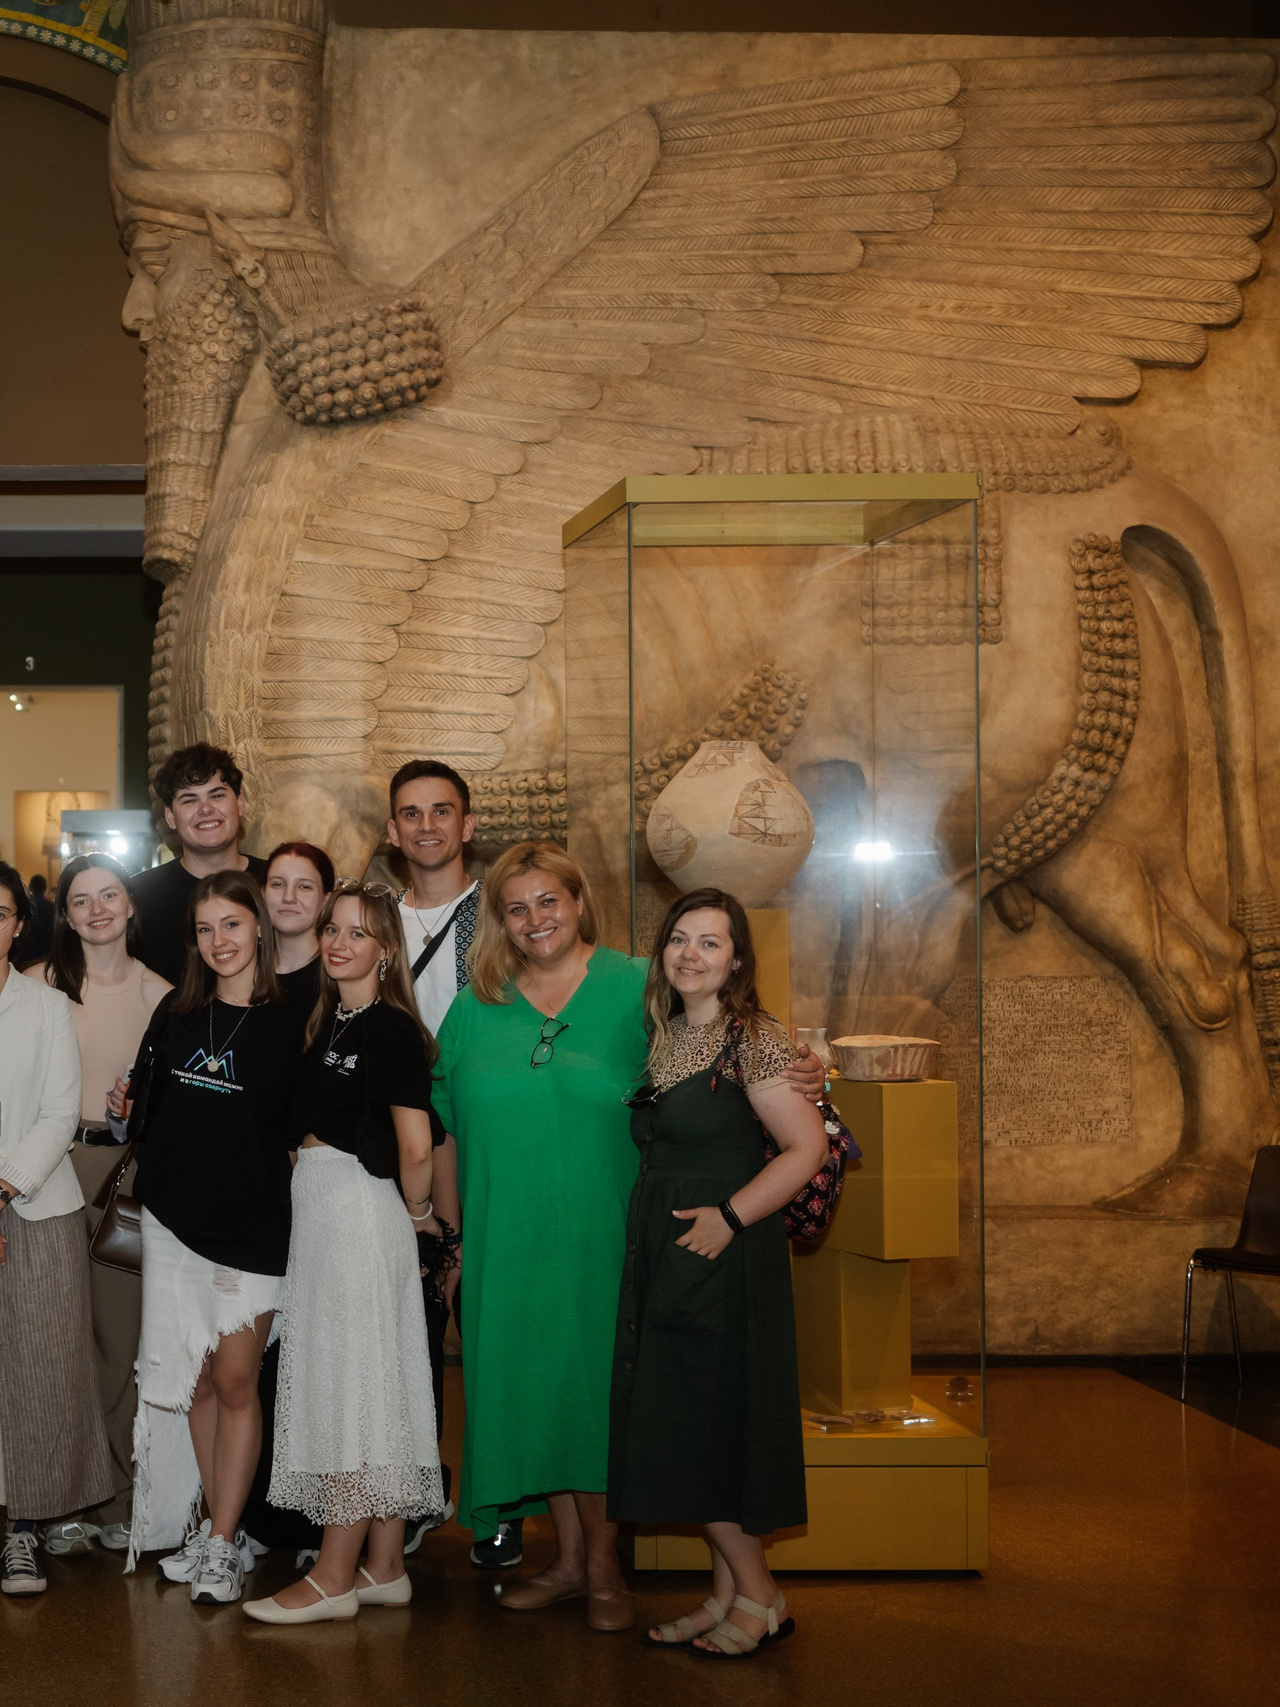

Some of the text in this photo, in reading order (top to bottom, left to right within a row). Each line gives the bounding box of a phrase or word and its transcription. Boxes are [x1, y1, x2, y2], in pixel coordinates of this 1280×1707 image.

[25, 656, 34, 671] 3
[175, 1070, 193, 1079] такой
[192, 1074, 224, 1087] командой
[223, 1081, 244, 1091] можно
[188, 1080, 205, 1088] горы
